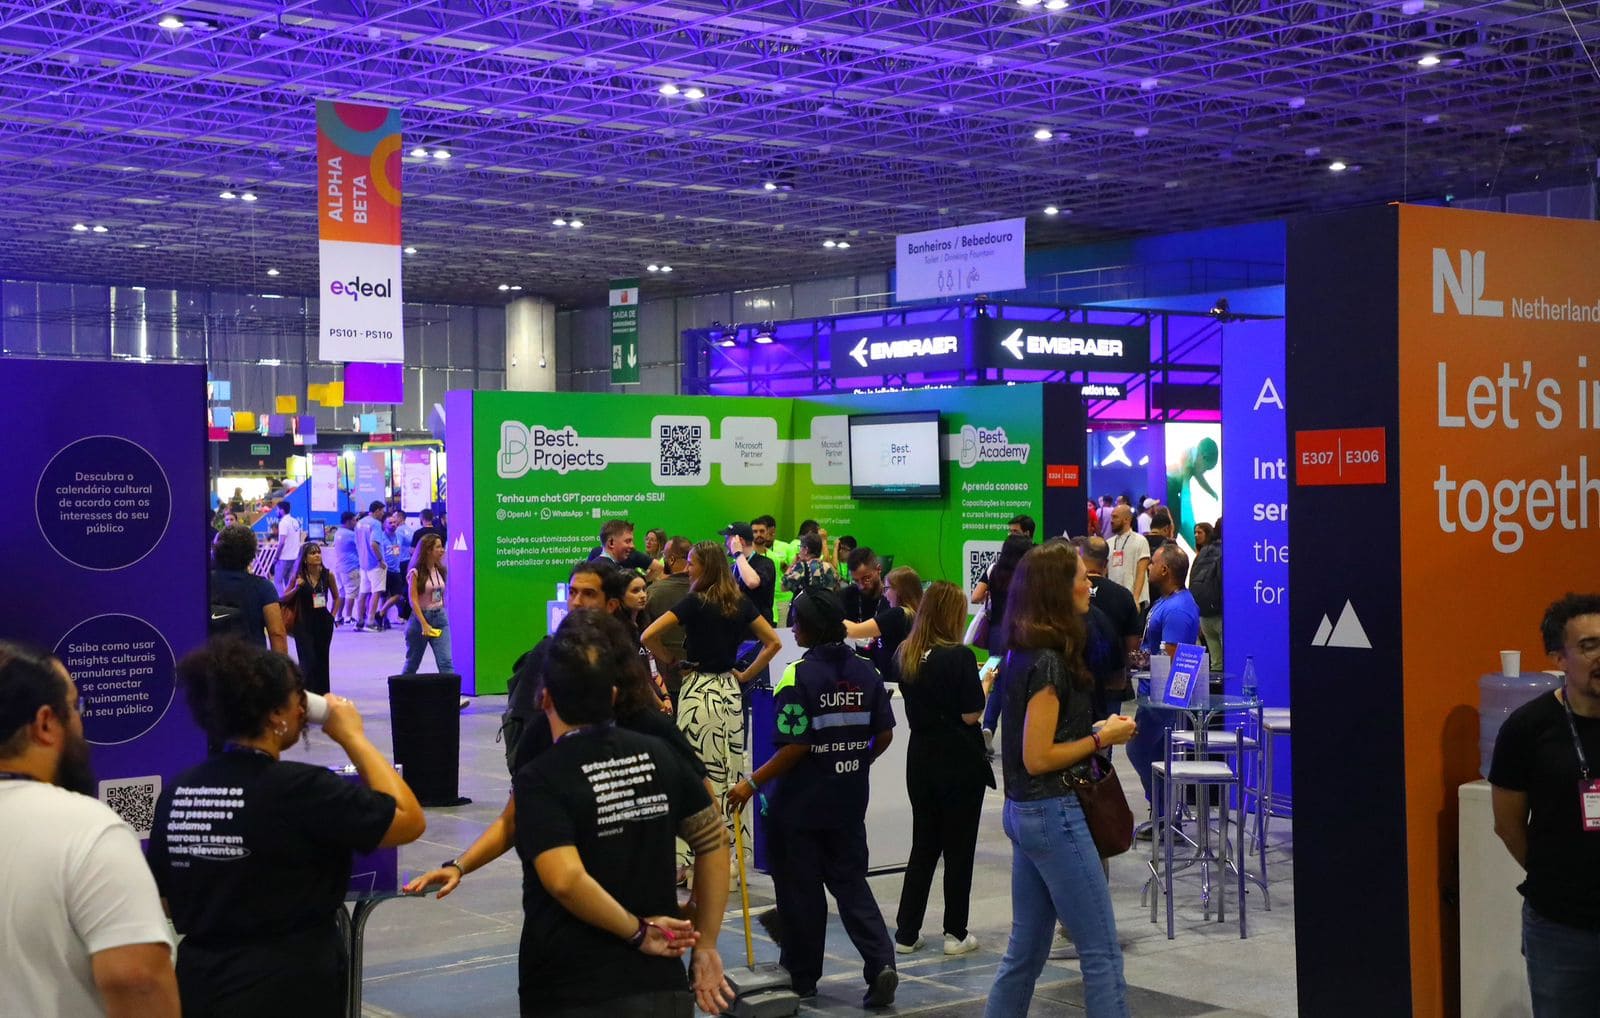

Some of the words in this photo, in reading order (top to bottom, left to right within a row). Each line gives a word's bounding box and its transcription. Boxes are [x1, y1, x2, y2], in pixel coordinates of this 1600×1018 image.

[328, 156, 343, 222] ALPHA
[353, 175, 367, 224] BETA
[908, 240, 952, 255] Banheiros
[961, 232, 1013, 248] Bebedouro
[1433, 247, 1504, 317] NL
[329, 328, 357, 338] PS101
[365, 330, 393, 340] PS110
[870, 336, 958, 360] EMBRAER
[1026, 336, 1123, 357] EMBRAER
[1438, 360, 1563, 429] Let's
[534, 429, 579, 447] Best.
[979, 431, 1006, 444] Best.
[735, 441, 763, 450] Microsoft
[891, 443, 911, 453] Best.
[740, 450, 763, 458] Partner
[979, 446, 1028, 460] Academy
[1302, 451, 1333, 465] E307
[1345, 450, 1379, 463] E306
[534, 449, 605, 470] Projects
[75, 472, 124, 481] Descubra
[56, 484, 111, 494] calendário
[114, 484, 152, 494] cultural
[962, 482, 994, 492] Aprenda
[995, 482, 1028, 491] conosco
[59, 498, 72, 507] de
[75, 498, 111, 507] acordo
[114, 499, 135, 507] com
[138, 499, 150, 507] os
[496, 494, 524, 503] Tenha
[540, 494, 560, 502] chat
[562, 493, 580, 502] GPT
[581, 495, 601, 504] para
[602, 493, 633, 502] chamar
[634, 493, 645, 501] de
[646, 492, 665, 501] SEU!
[60, 511, 112, 520] interesses
[115, 510, 128, 519] do
[131, 511, 149, 519] seu
[507, 510, 532, 519] OpenAI
[552, 509, 583, 519] WhatsApp
[602, 509, 628, 517] Microsoft
[86, 523, 124, 535] público
[496, 535, 529, 545] Soluções
[530, 534, 579, 543] customizadas
[496, 547, 539, 558] Inteligência
[541, 546, 570, 555] Artificial
[496, 555, 544, 568] potencializar
[1254, 580, 1285, 604] for
[68, 642, 99, 653] Saiba
[101, 642, 130, 651] como
[132, 641, 155, 650] usar
[68, 655, 109, 667] insights
[111, 652, 156, 663] culturais
[70, 667, 126, 680] granulares
[129, 666, 153, 677] para
[82, 683, 94, 691] se
[97, 680, 142, 690] conectar
[95, 707, 113, 716] seu
[116, 704, 154, 718] público
[832, 742, 846, 752] DE
[835, 760, 860, 773] 008
[175, 786, 228, 796] Entendemos
[229, 786, 243, 796] os
[193, 797, 245, 808] interesses
[185, 810, 225, 820] pessoas
[167, 820, 212, 831] ajudamos
[210, 835, 243, 844] serem
[188, 845, 244, 856] relevantes
